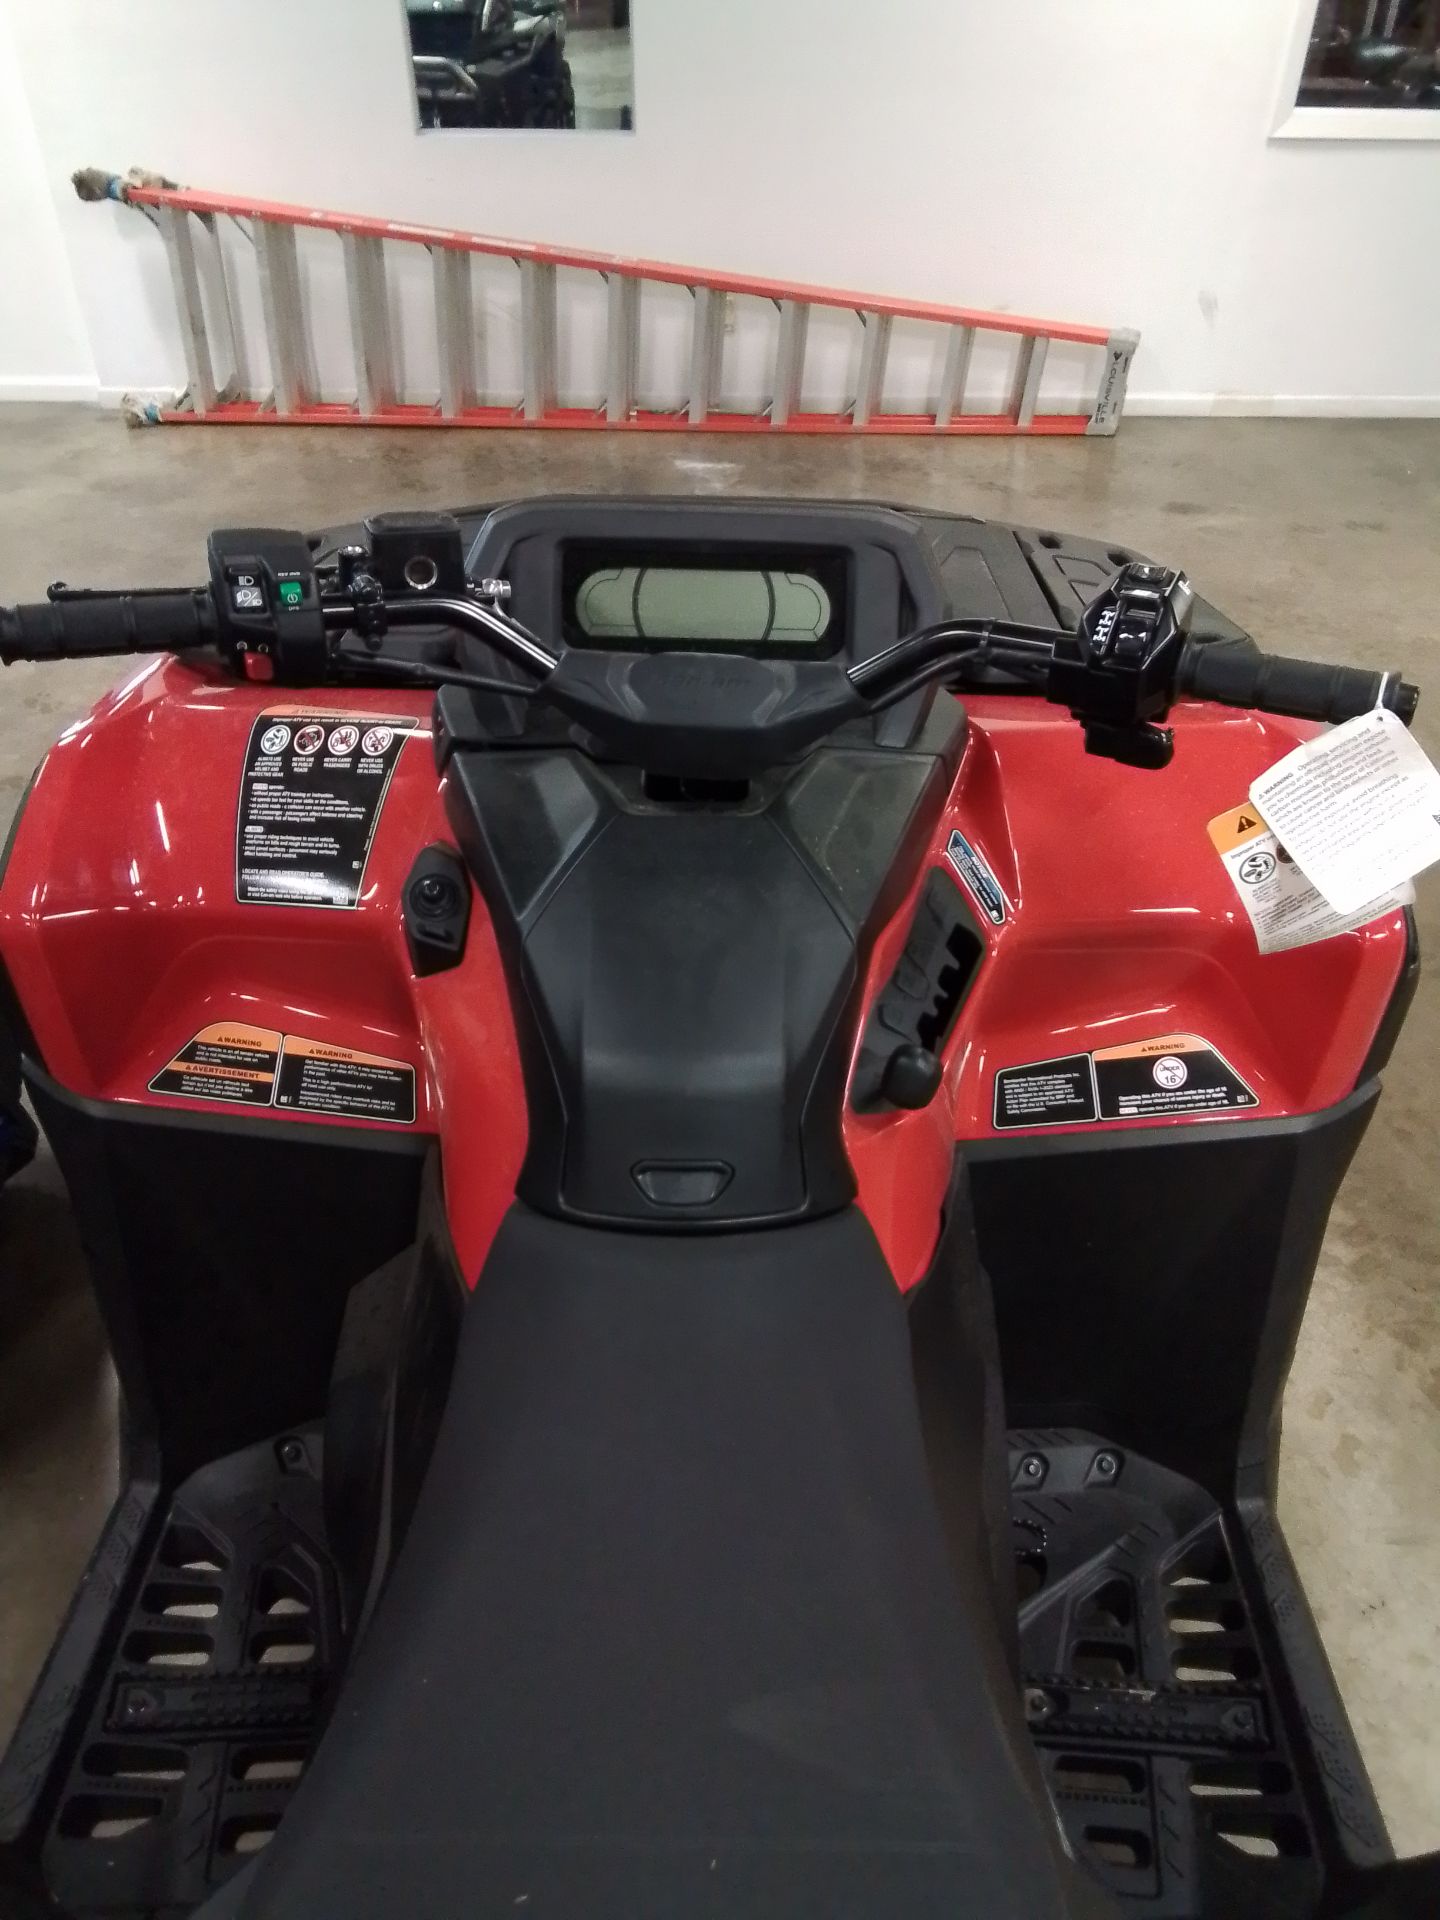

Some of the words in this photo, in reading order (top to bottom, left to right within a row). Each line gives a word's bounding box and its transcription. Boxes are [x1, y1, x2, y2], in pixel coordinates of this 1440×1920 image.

[224, 1036, 262, 1047] WARNING
[1148, 1043, 1186, 1051] WARNING
[315, 1048, 353, 1059] WARNING
[192, 1065, 260, 1078] AVERTISSEMENT
[1165, 1075, 1176, 1084] 16
